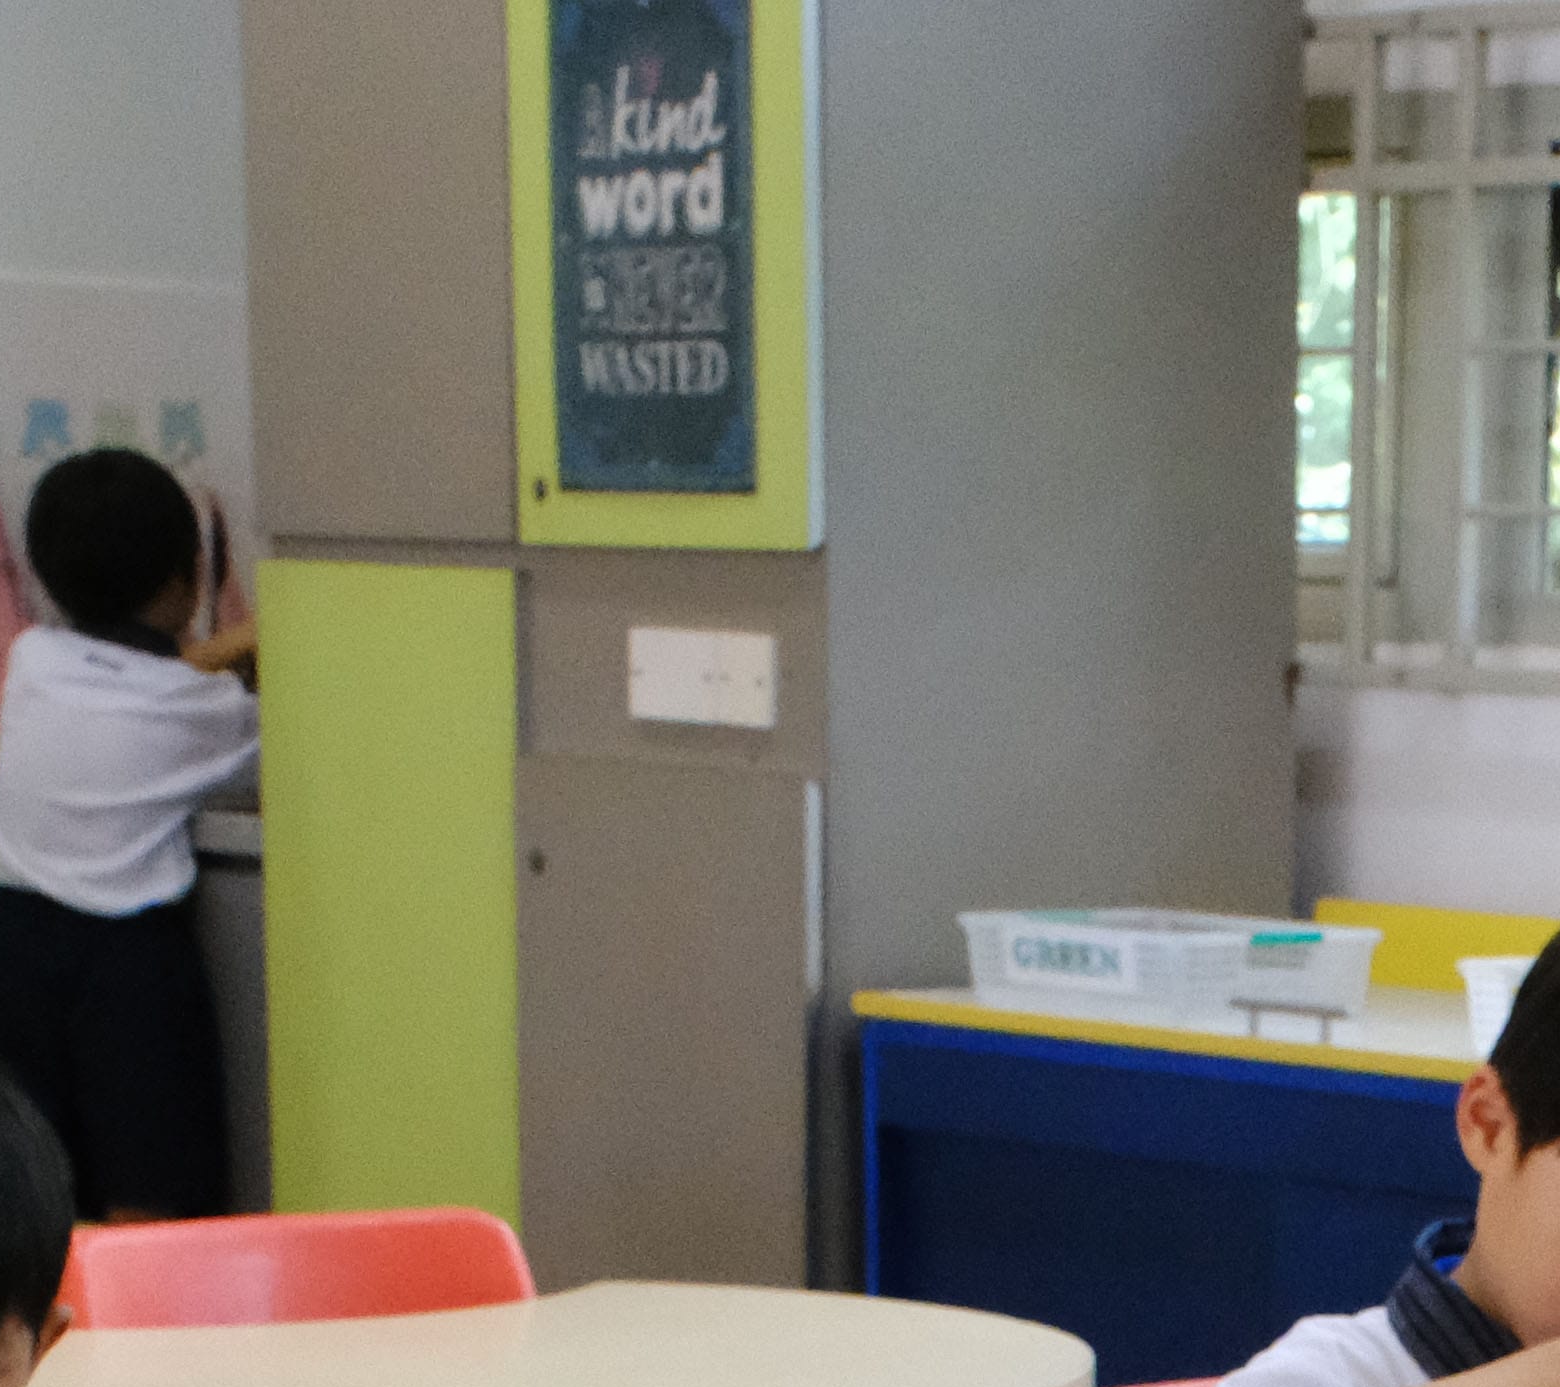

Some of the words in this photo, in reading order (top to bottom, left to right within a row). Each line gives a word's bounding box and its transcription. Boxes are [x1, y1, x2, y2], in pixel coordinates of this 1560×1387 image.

[611, 60, 727, 158] kind
[578, 150, 725, 237] word
[578, 338, 730, 395] WASTED
